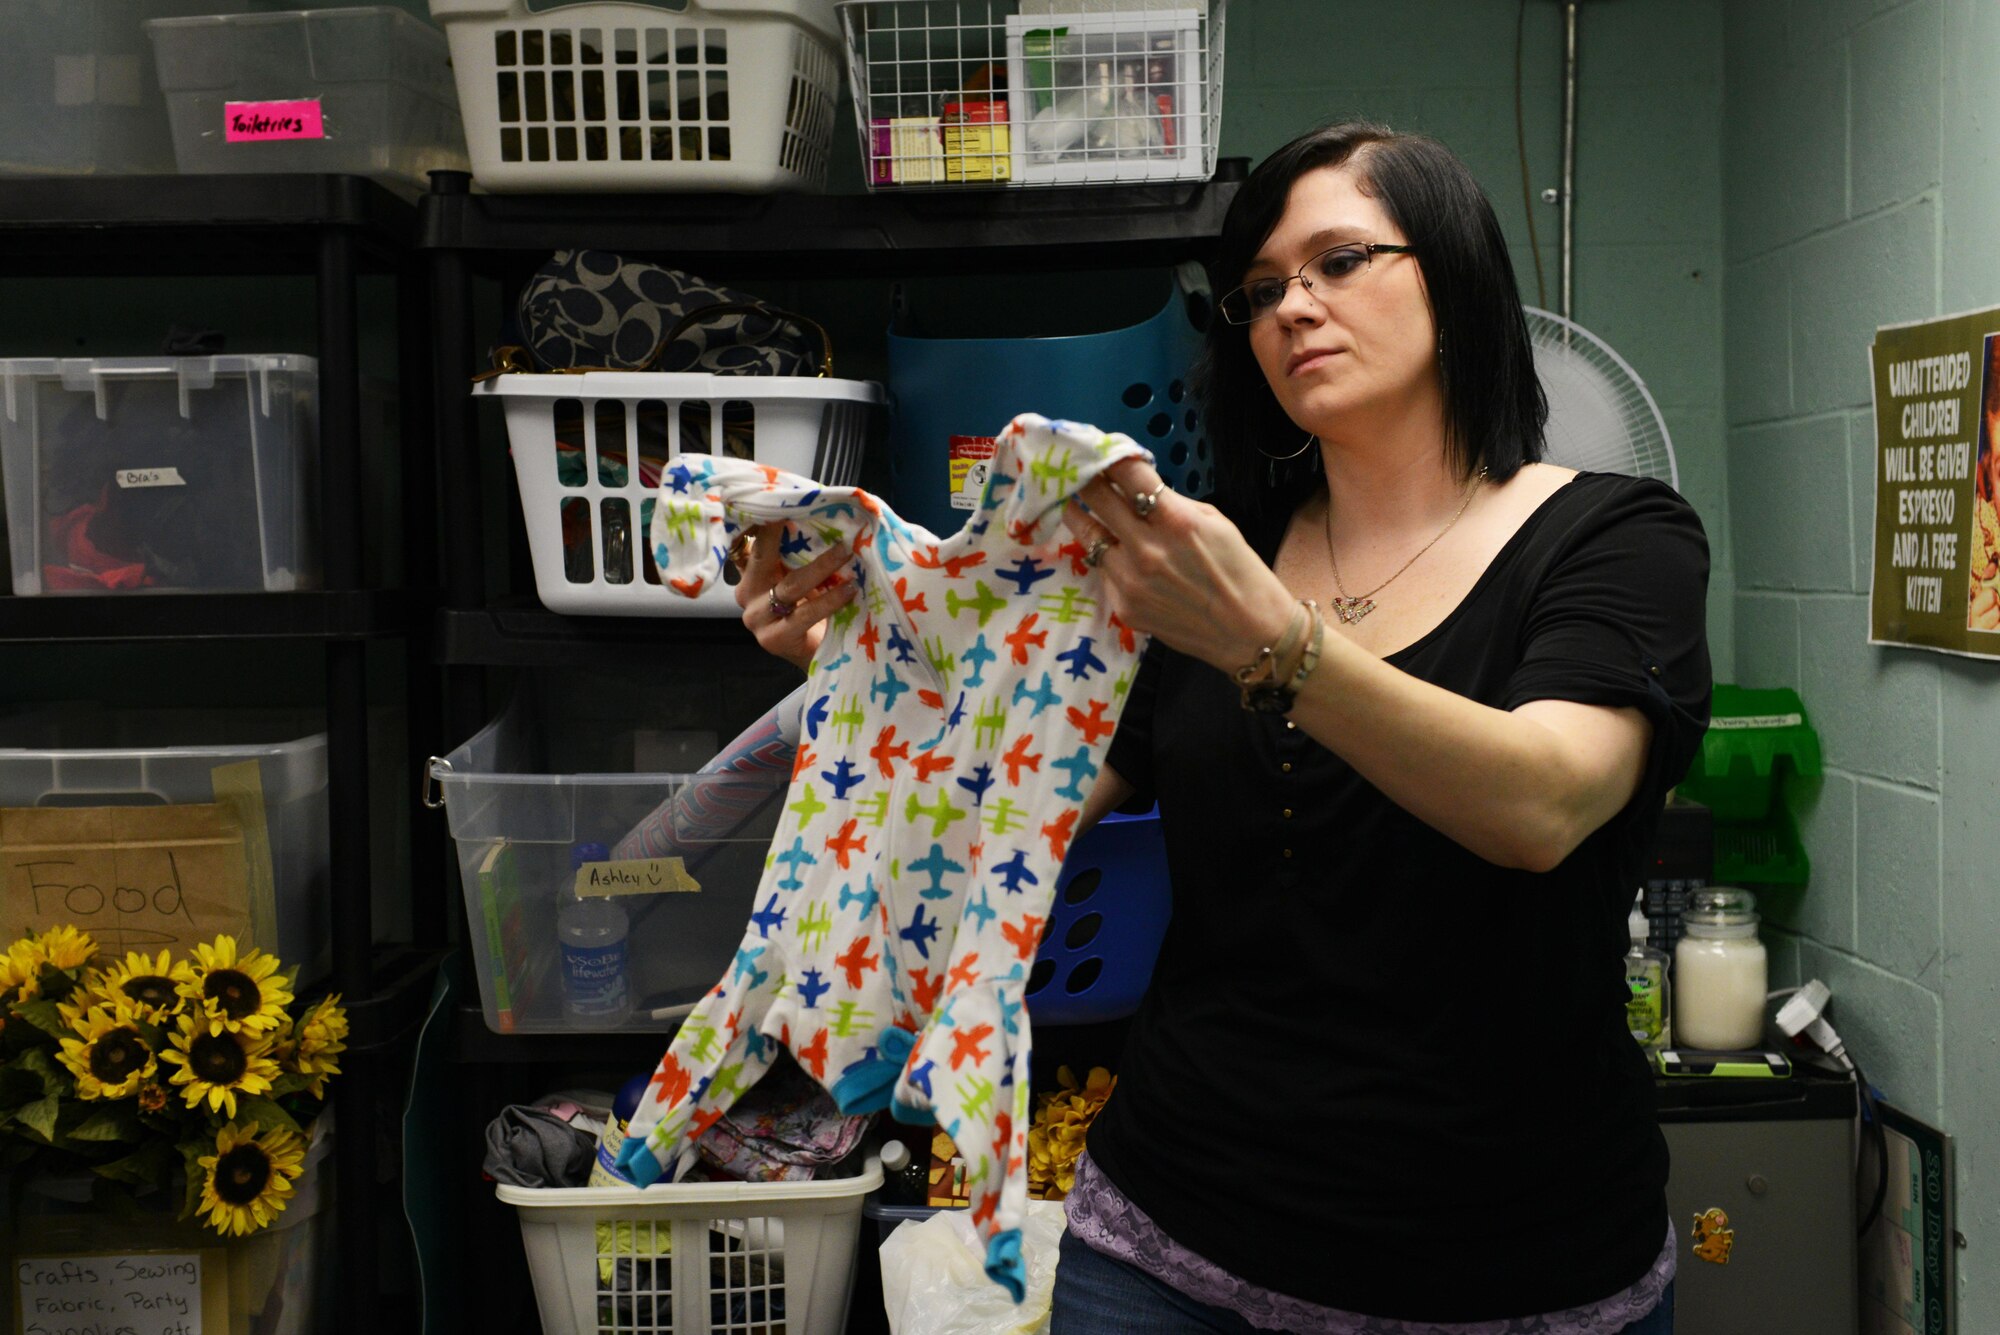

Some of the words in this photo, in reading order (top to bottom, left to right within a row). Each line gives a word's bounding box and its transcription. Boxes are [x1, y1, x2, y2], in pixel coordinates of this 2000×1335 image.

[1889, 351, 1971, 398] UNATTENDED
[1901, 397, 1960, 440] CHILDREN
[1885, 446, 1917, 483] WILL
[1919, 445, 1935, 482] BE
[1937, 441, 1970, 481] GIVEN
[1898, 487, 1956, 526] ESPRESSO
[1892, 531, 1919, 569] AND
[1921, 533, 1930, 569] A
[1931, 533, 1958, 570] FREE
[1906, 575, 1942, 614] KITTEN
[14, 850, 197, 927] Food
[589, 866, 641, 887] Ashley
[1912, 1172, 1920, 1204] SUN
[115, 1259, 198, 1285] Sewing
[1914, 1268, 1922, 1304] MON
[124, 1291, 189, 1315] Party
